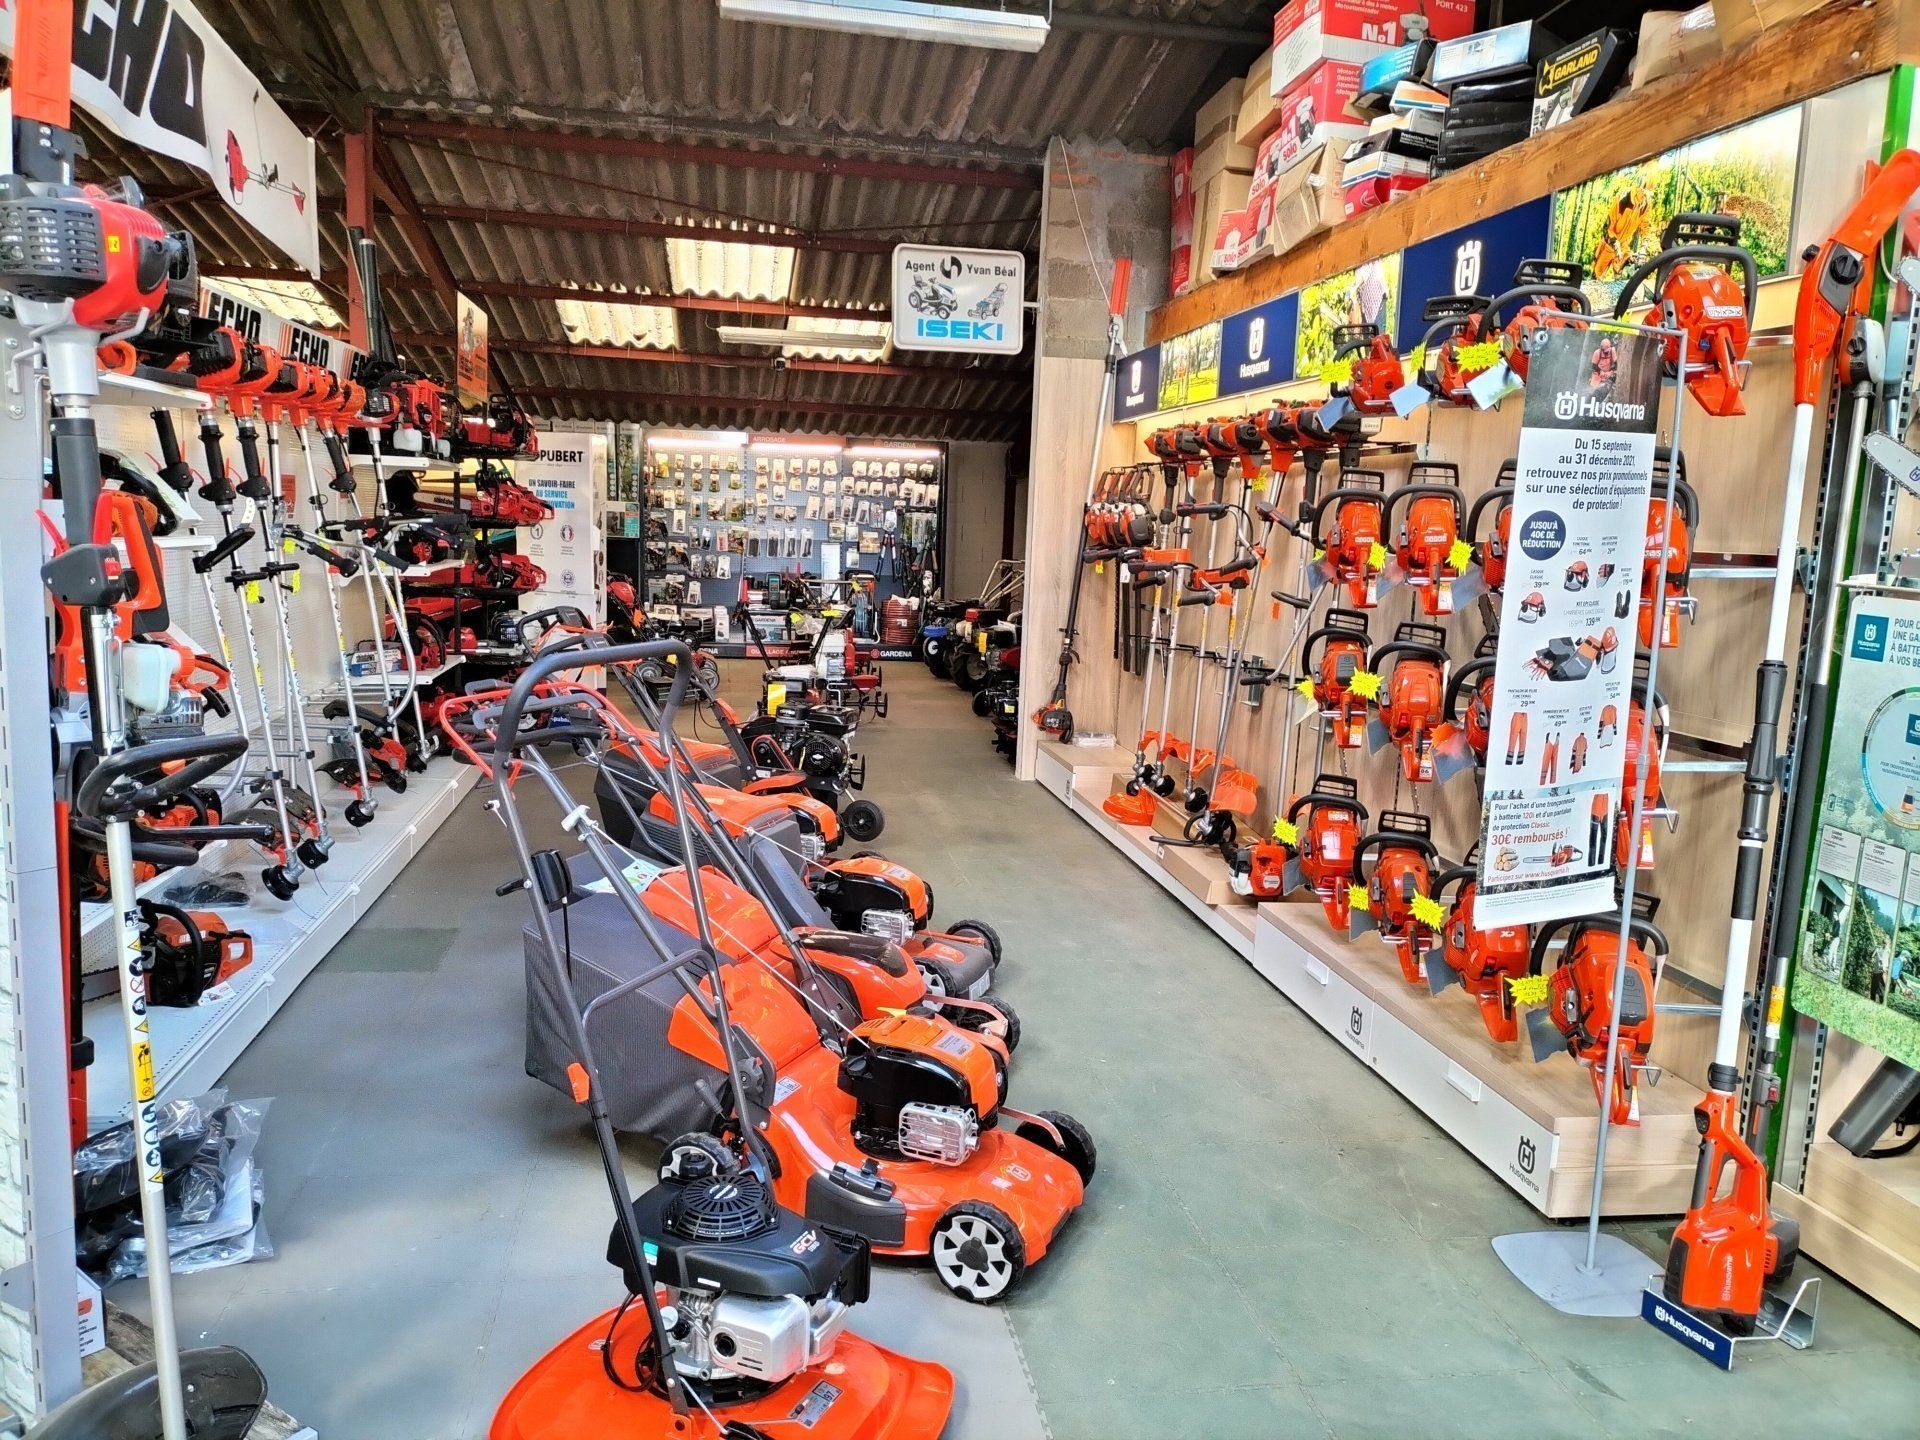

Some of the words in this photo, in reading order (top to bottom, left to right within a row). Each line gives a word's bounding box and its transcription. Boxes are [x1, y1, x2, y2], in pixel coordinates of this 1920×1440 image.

[1555, 50, 1598, 80] GARLAND
[1282, 142, 1298, 161] solo
[1251, 179, 1265, 195] solo
[1237, 242, 1249, 258] solo
[1223, 251, 1236, 264] solo
[905, 260, 935, 272] Agent
[967, 264, 991, 276] Yvan
[994, 266, 1016, 277] Béal
[208, 292, 262, 345] ECHO
[917, 318, 1003, 341] ISEKI
[291, 327, 329, 368] ECHO
[1240, 360, 1270, 379] Husqvarna
[1579, 396, 1646, 421] Husqvarna
[883, 441, 916, 449] GARDENA
[1575, 438, 1588, 450] Du
[1591, 438, 1601, 450] 15
[1602, 441, 1632, 453] septembre
[540, 449, 583, 463] PUBERT
[1558, 455, 1572, 464] au
[1575, 453, 1587, 464] 31
[1588, 454, 1623, 466] décembre
[1526, 468, 1578, 480] retrouvez
[1581, 471, 1597, 480] nos
[1598, 470, 1612, 482] prix
[1612, 470, 1648, 482] promotionnels
[528, 479, 537, 487] UN
[537, 479, 576, 489] SAVOIR-FAIRE
[1525, 484, 1543, 493] sur
[1546, 485, 1567, 494] une
[1569, 484, 1608, 495] sélection
[1608, 484, 1646, 497] d'équipements
[536, 489, 544, 498] AU
[544, 490, 568, 499] SERVICE
[1572, 498, 1584, 510] de
[1586, 499, 1619, 512] protection
[1529, 520, 1559, 530] JUSQU'À
[1530, 530, 1545, 539] 40€
[1546, 531, 1556, 539] DE
[1522, 539, 1561, 549] RÉDUCTION
[1894, 618, 1914, 629] POUR
[1892, 630, 1907, 641] UNE
[880, 650, 913, 658] GARDENA
[1897, 655, 1911, 666] VOS
[1530, 801, 1546, 809] d'une
[1499, 812, 1521, 820] batterie
[1542, 810, 1553, 818] d'un
[1500, 822, 1530, 832] protection
[1530, 821, 1550, 829] Classic
[1491, 833, 1512, 845] 30€
[1513, 829, 1564, 844] remboursés
[1487, 873, 1514, 883] Participez
[1345, 1029, 1365, 1050] Husqvarna
[1509, 1162, 1540, 1194] Husqvarna
[793, 1229, 817, 1255] GCV
[1724, 1254, 1734, 1294] Husqvarna
[1665, 1312, 1715, 1351] Husqvarna
